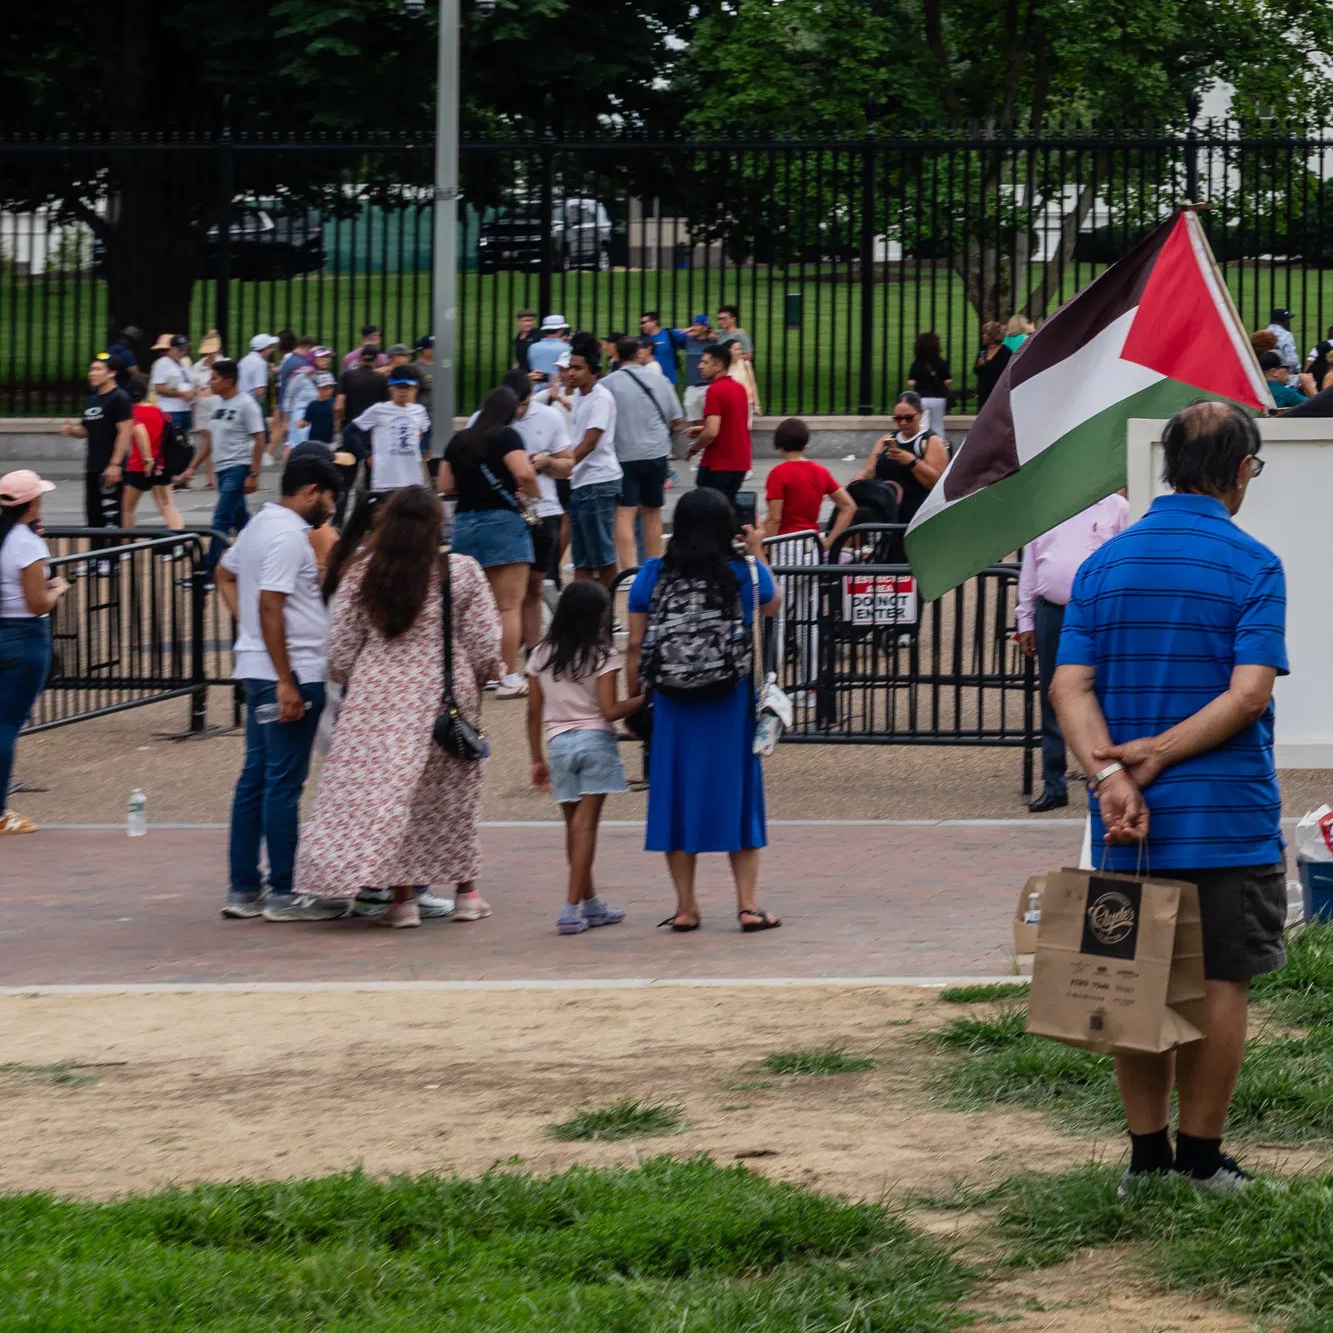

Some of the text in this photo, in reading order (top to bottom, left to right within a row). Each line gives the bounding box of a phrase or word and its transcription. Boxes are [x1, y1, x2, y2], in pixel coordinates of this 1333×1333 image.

[852, 595, 909, 608] DO NOT
[856, 608, 906, 619] ENTER
